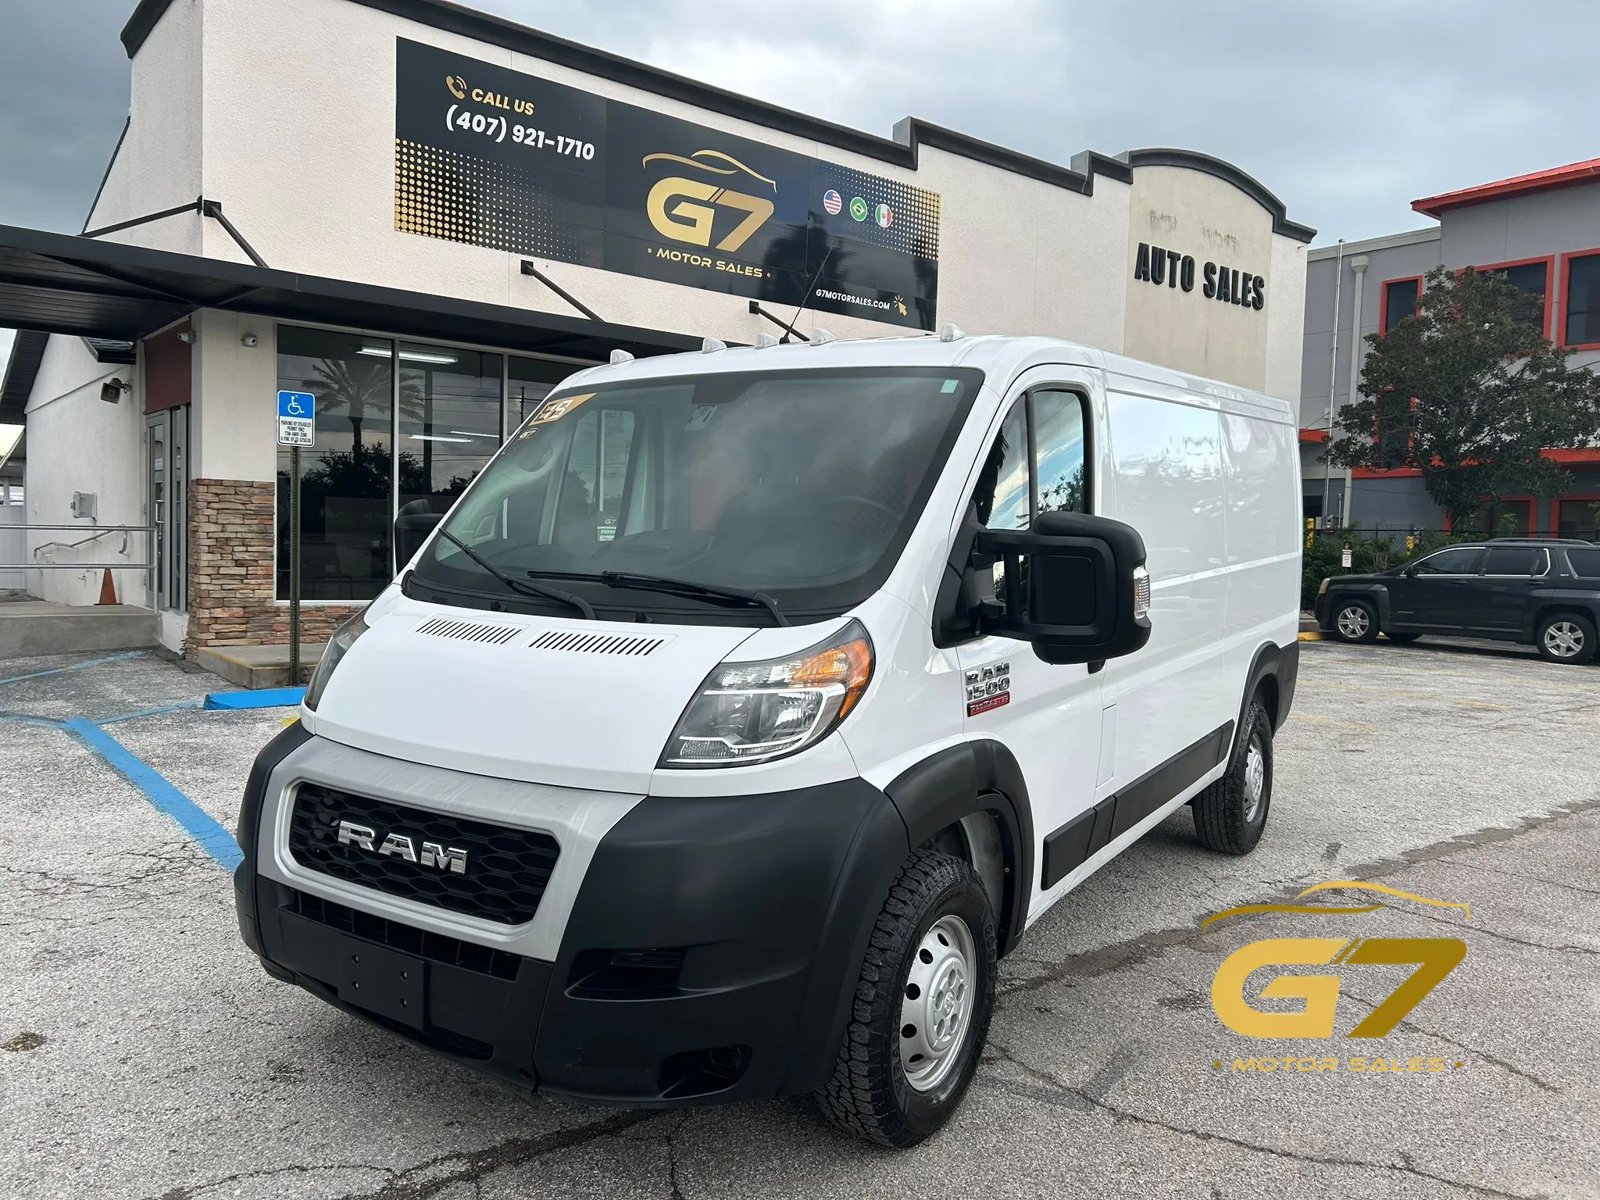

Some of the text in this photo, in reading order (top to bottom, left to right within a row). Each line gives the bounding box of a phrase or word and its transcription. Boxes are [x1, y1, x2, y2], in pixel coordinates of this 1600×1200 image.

[471, 88, 535, 116] CALL US
[446, 104, 595, 161] (407) 921-1710
[647, 176, 775, 252] G7
[656, 248, 763, 278] MOTOR SALES
[1134, 242, 1265, 311] AUTO SALES
[815, 288, 891, 310] G7MOTORSALES.COM
[965, 662, 1010, 686] RAM
[966, 676, 1010, 701] 1500
[337, 820, 468, 874] RAM
